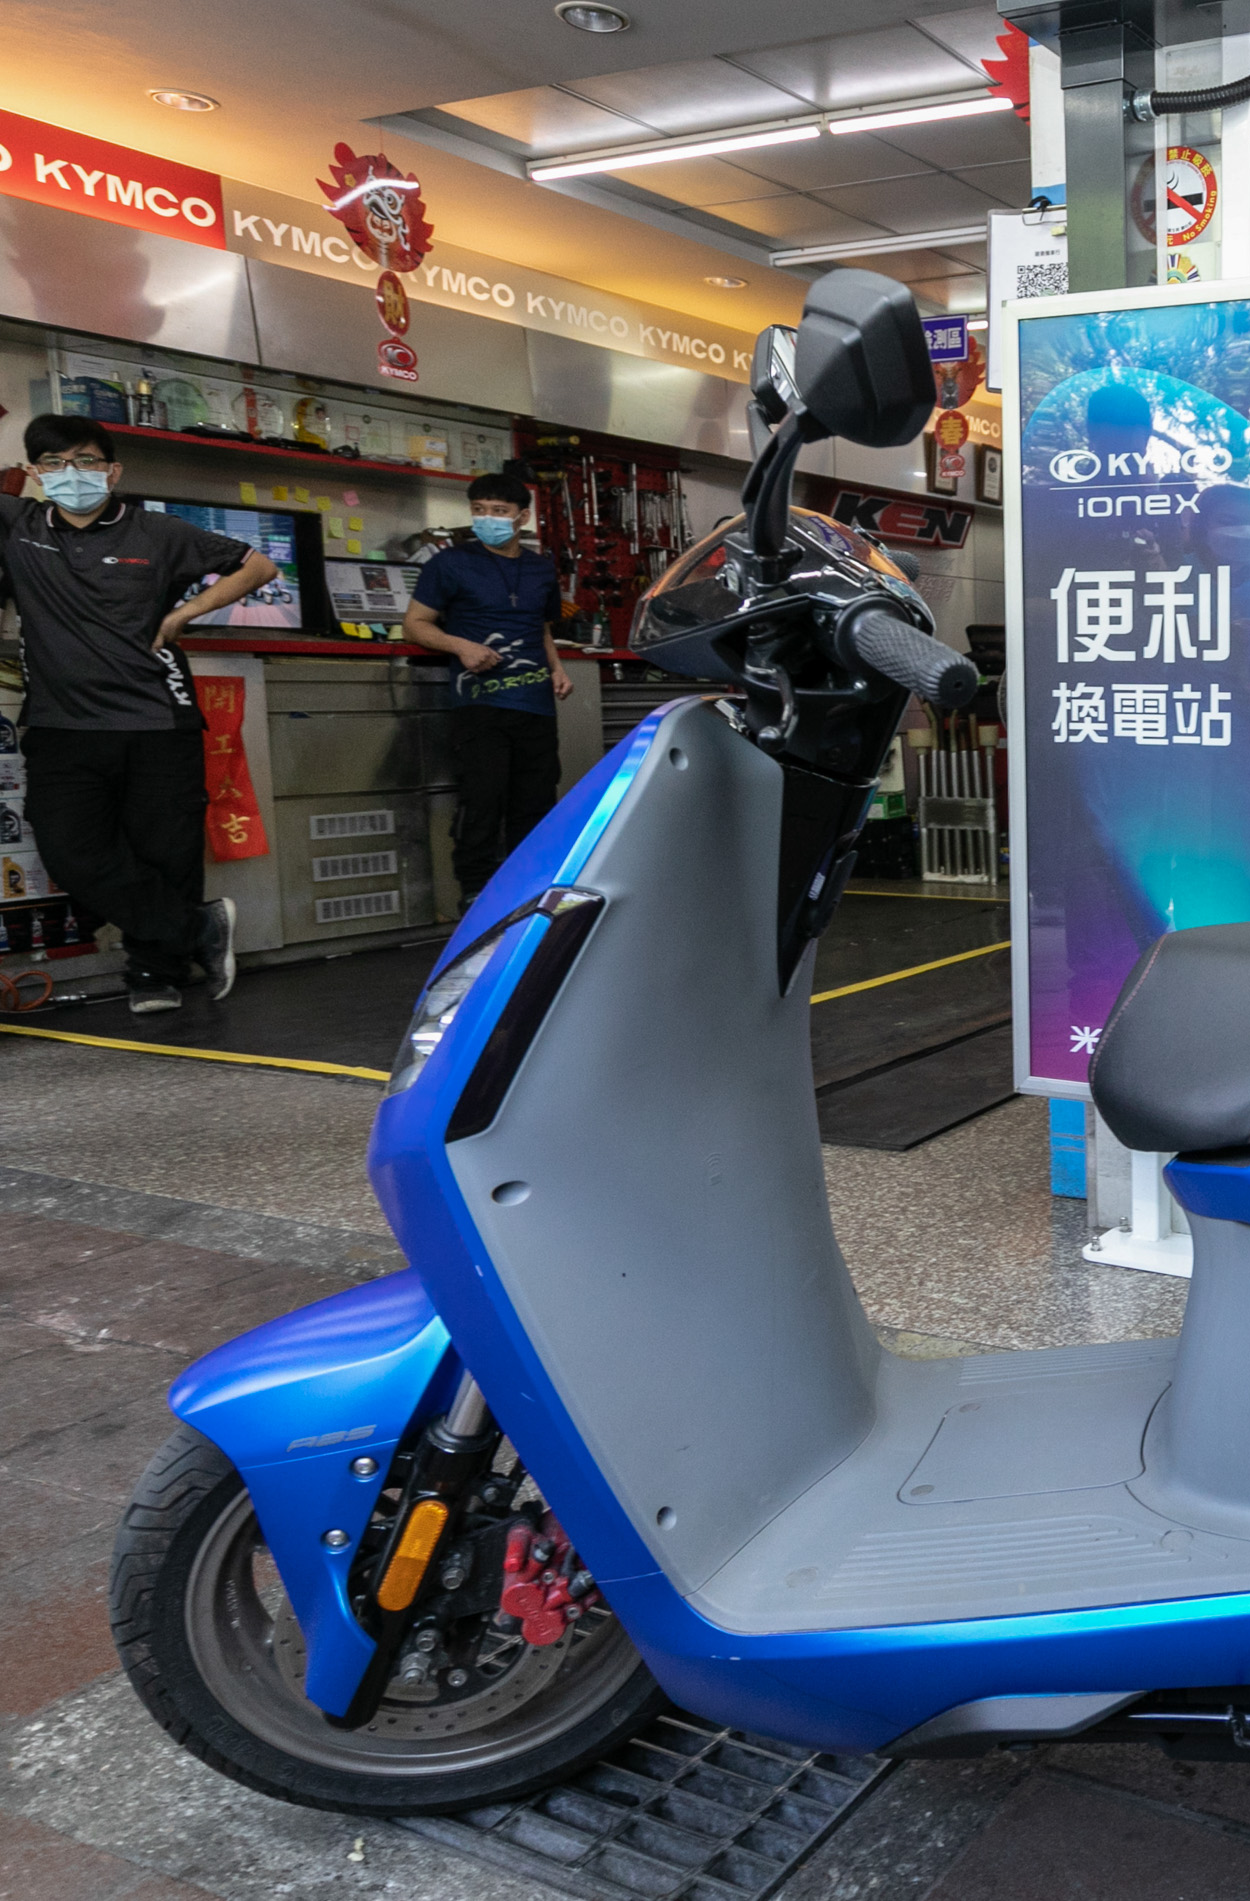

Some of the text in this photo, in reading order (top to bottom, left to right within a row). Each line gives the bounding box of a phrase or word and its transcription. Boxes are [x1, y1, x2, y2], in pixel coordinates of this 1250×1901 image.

[34, 152, 217, 228] KYMCO
[1182, 231, 1196, 242] No
[526, 291, 629, 338] KYMCO
[638, 322, 726, 365] KYMCO
[1106, 447, 1233, 476] KYMCO
[831, 493, 972, 546] KEN
[1077, 493, 1202, 518] ionex
[1050, 565, 1232, 664] 便利
[156, 648, 192, 706] KYMC
[1050, 682, 1233, 747] 換電站
